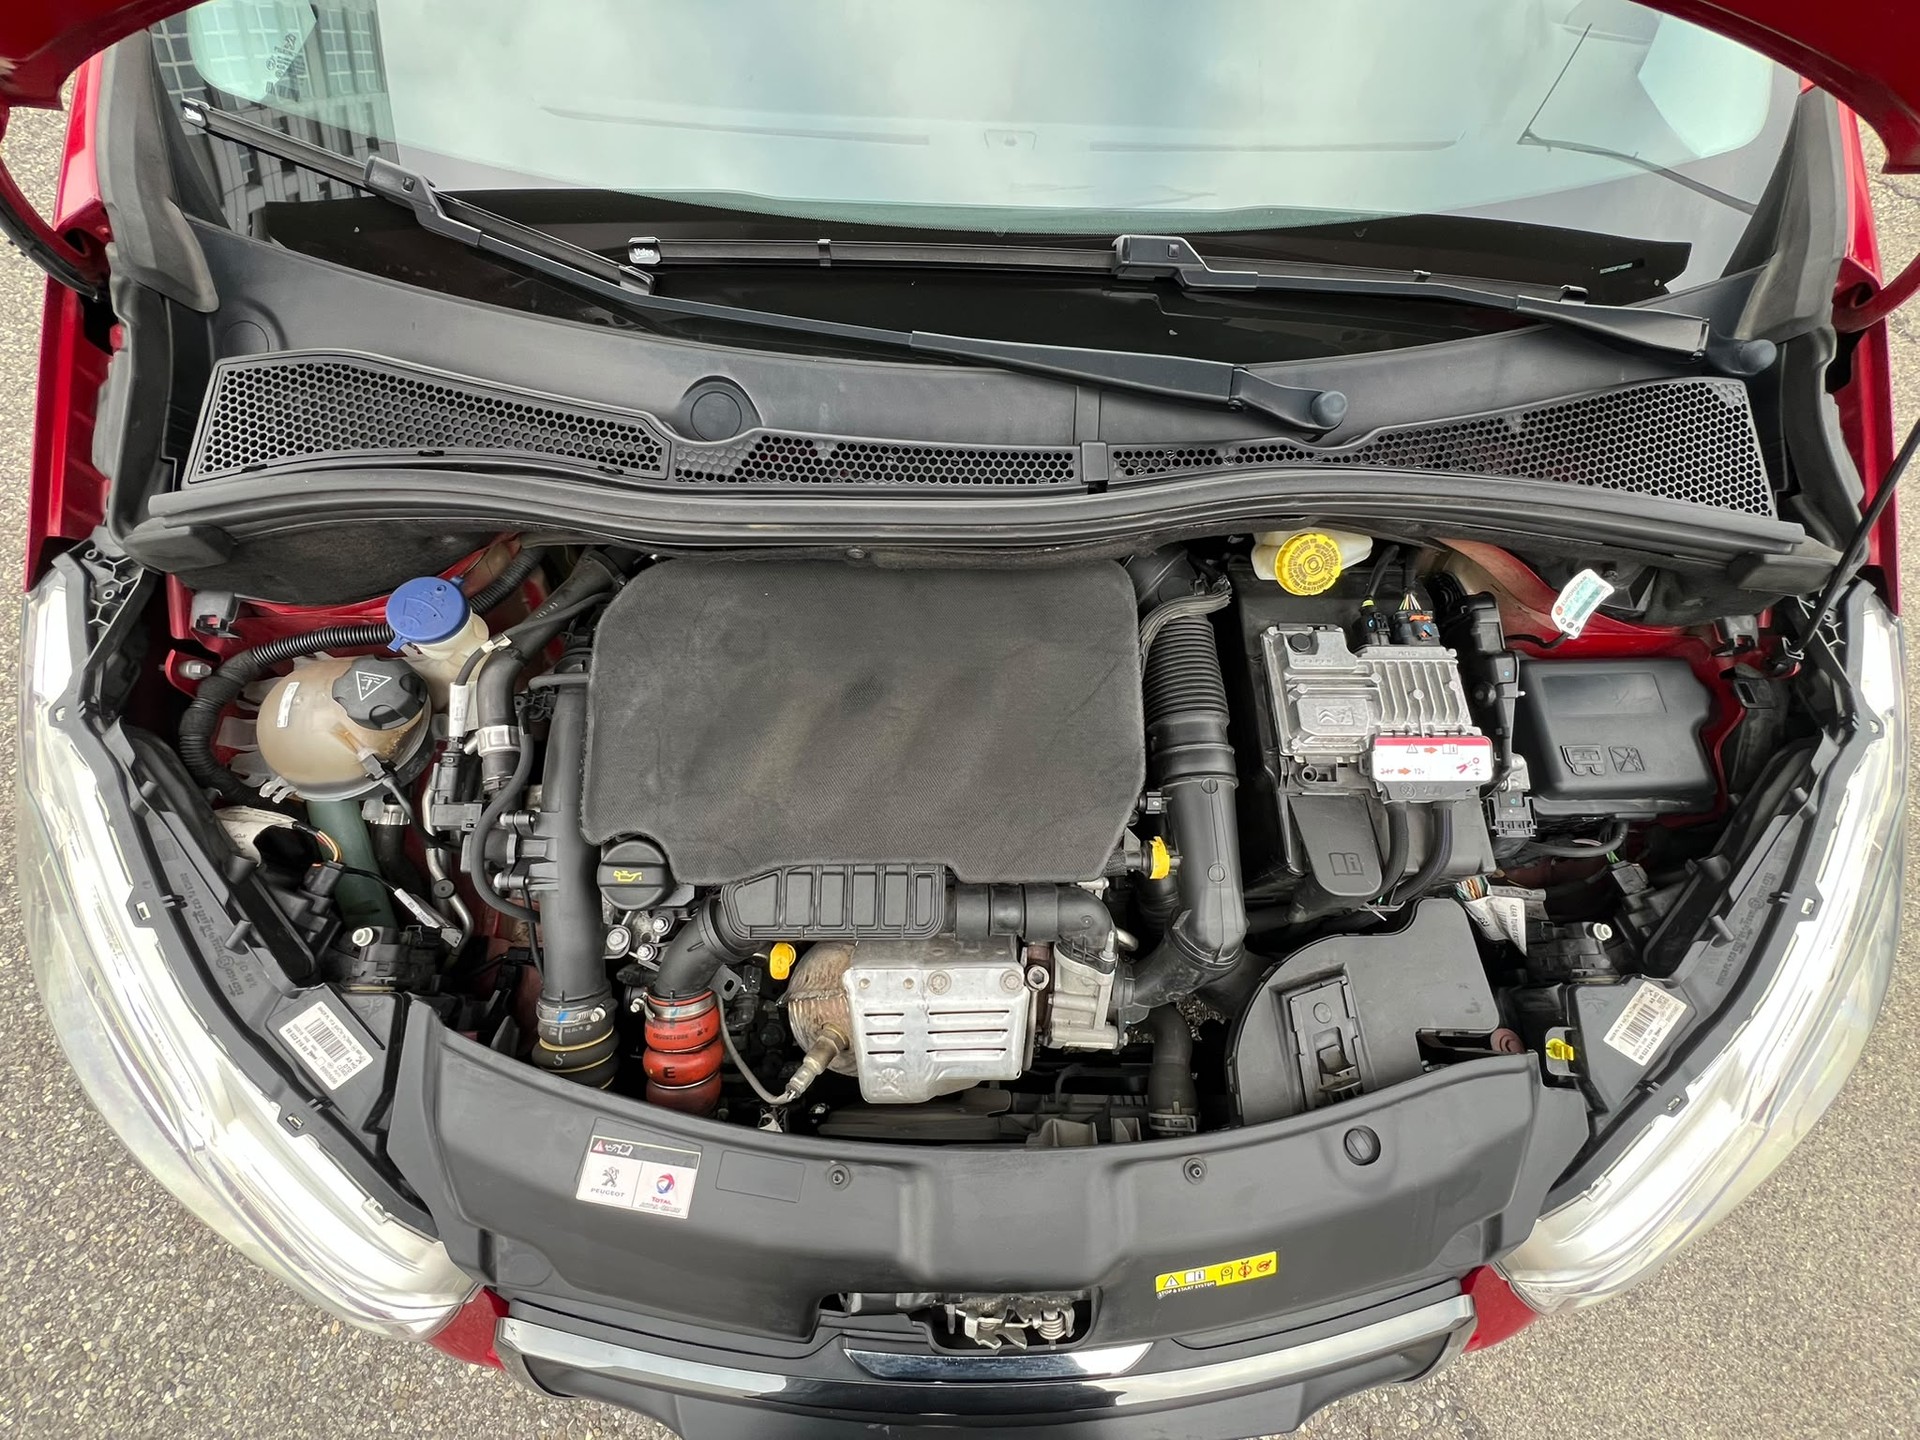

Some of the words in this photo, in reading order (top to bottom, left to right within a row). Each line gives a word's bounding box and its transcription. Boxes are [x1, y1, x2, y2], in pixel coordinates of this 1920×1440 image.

[633, 247, 655, 257] Valeo
[663, 1066, 676, 1079] E
[590, 1187, 625, 1198] PEUGEOT
[651, 1196, 672, 1205] TOTAL
[1178, 1285, 1194, 1293] START
[1195, 1281, 1216, 1290] SYSTEM
